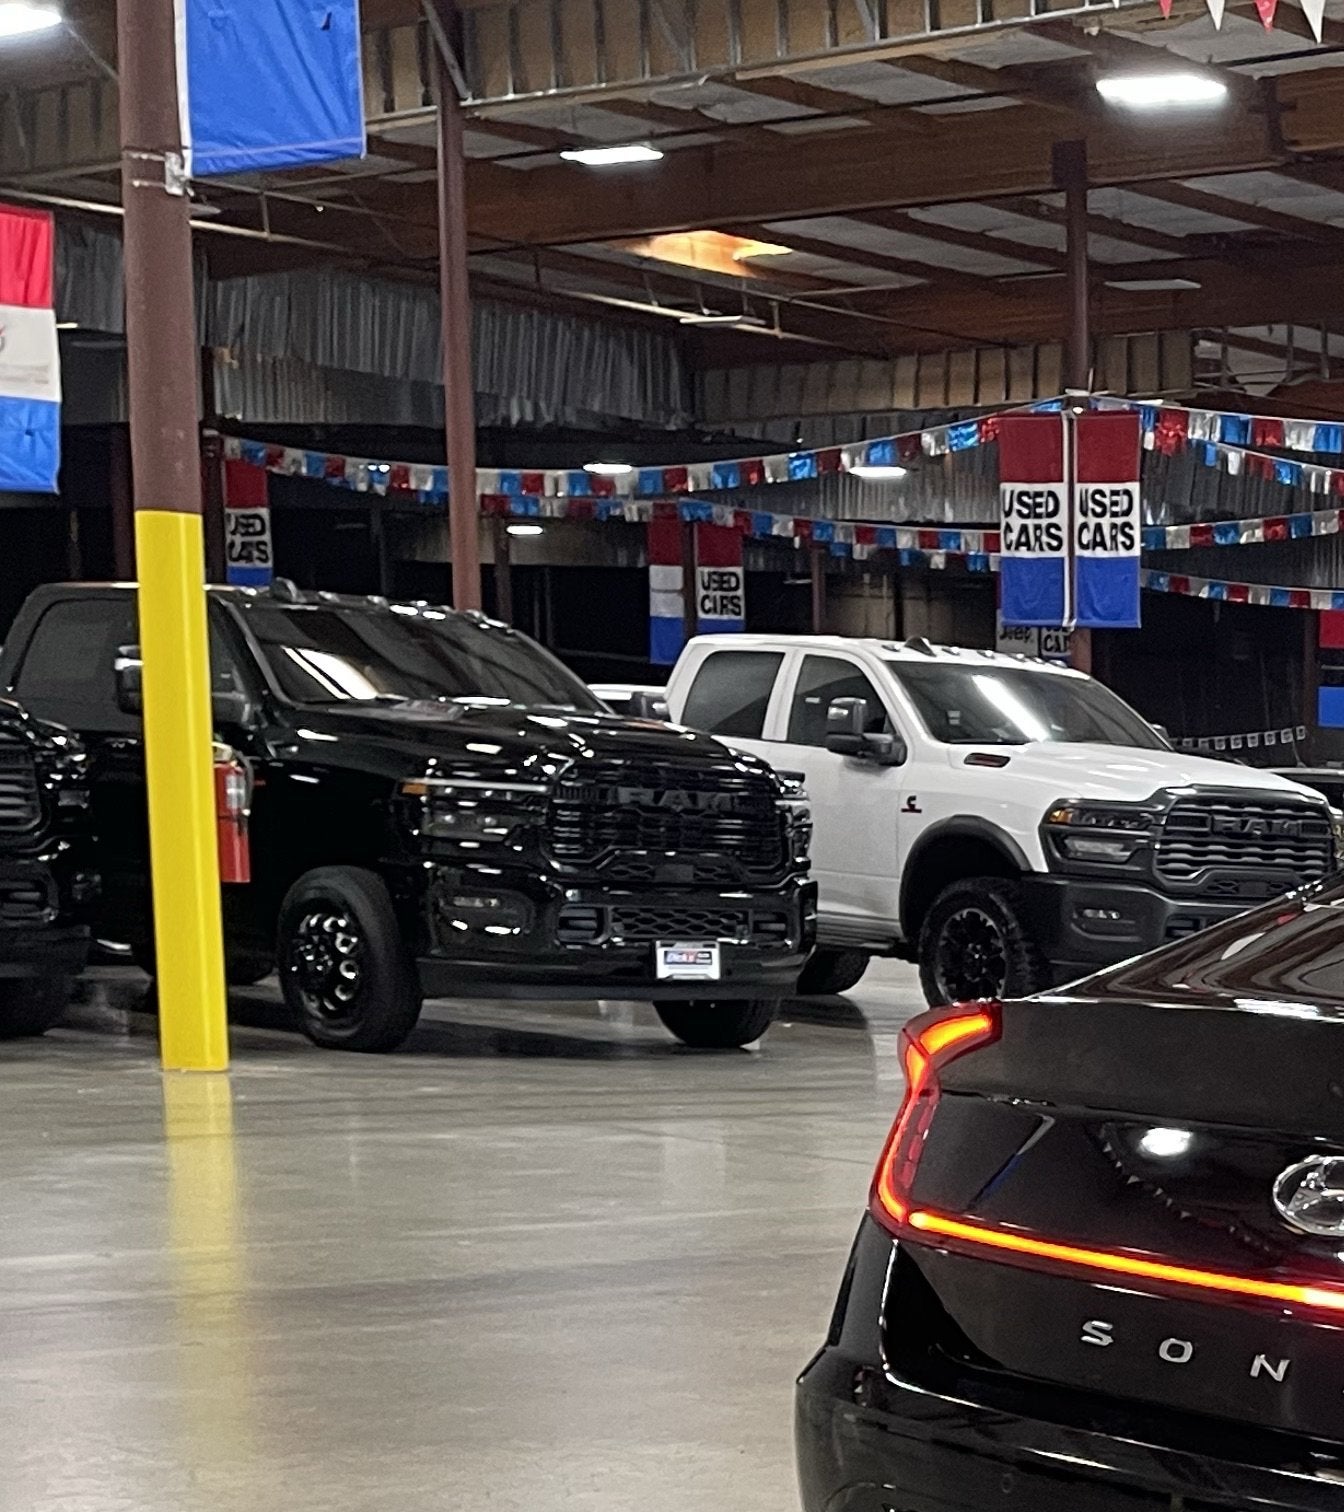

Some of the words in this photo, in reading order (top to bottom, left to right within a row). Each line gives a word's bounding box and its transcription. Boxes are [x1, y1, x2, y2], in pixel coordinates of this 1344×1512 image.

[1003, 489, 1060, 519] USED
[1079, 489, 1133, 518] USED
[1004, 521, 1063, 551] CARS
[1078, 521, 1135, 551] CARS
[701, 572, 740, 592] USED
